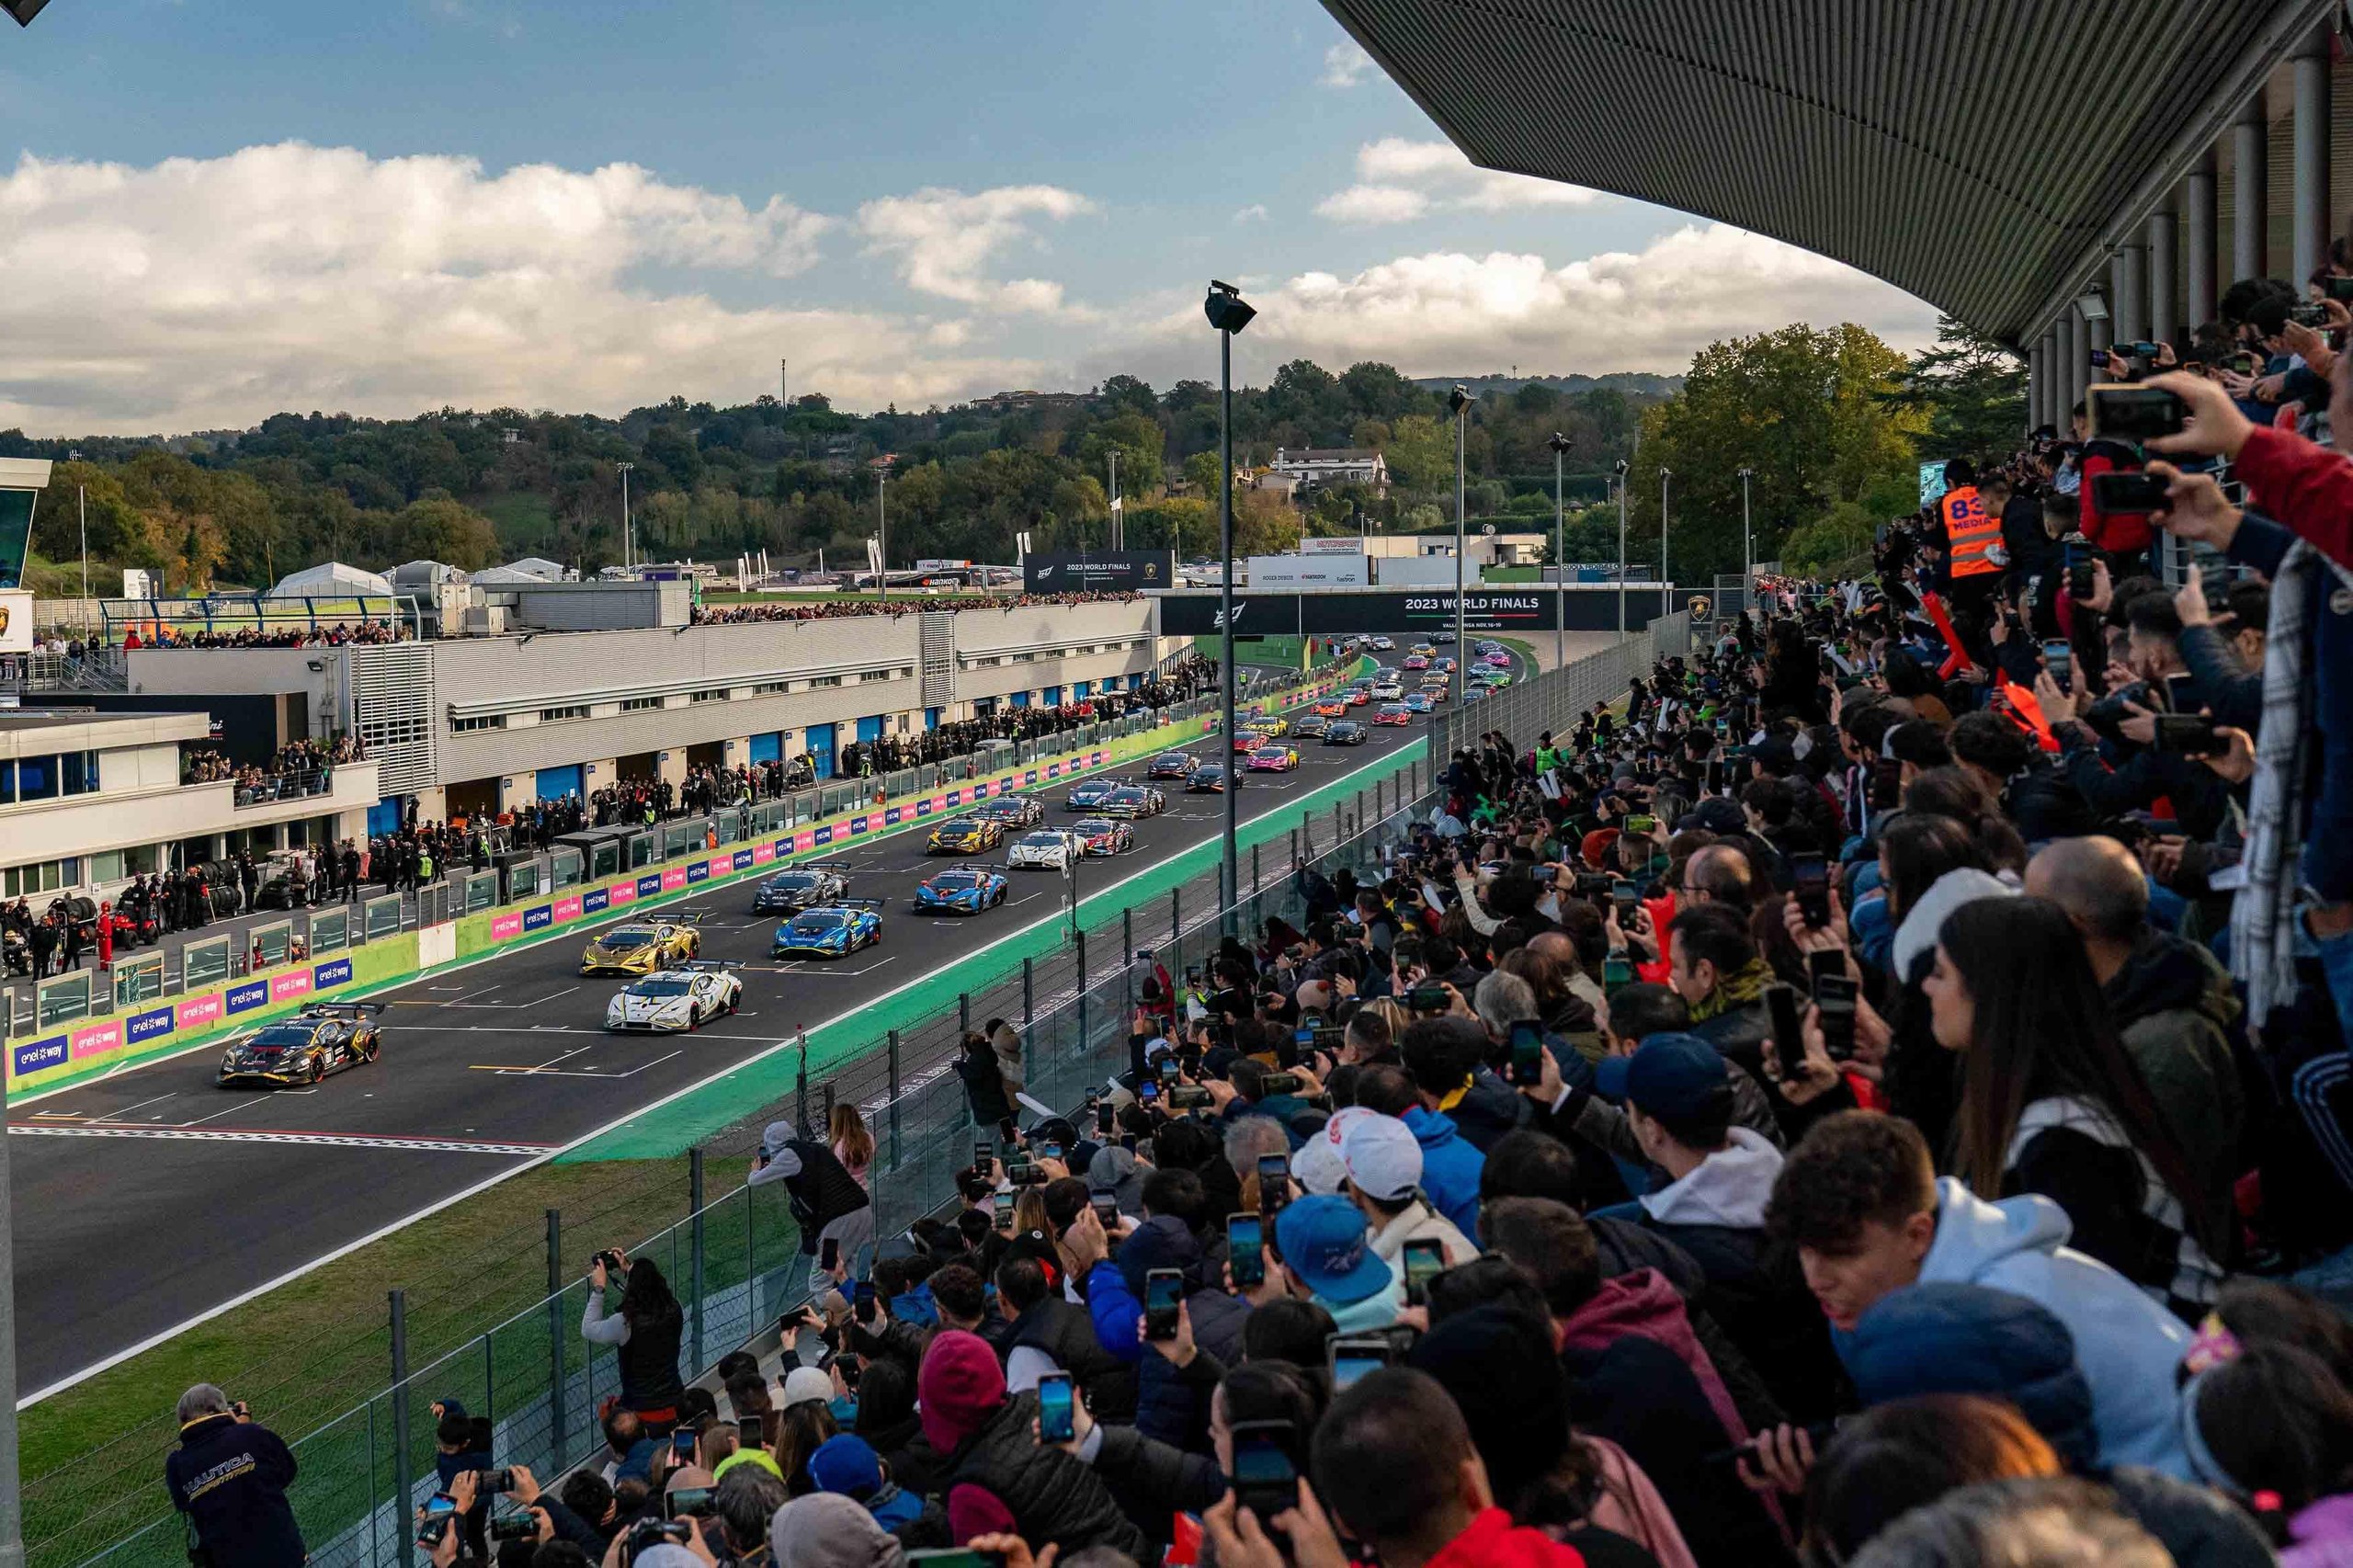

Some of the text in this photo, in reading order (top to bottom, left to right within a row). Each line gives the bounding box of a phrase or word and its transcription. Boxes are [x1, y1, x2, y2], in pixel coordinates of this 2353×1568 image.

[1953, 517, 1992, 529] MEDIA
[1404, 599, 1438, 608] 2023
[1492, 597, 1539, 608] FINALS
[320, 965, 348, 981] enel way
[277, 977, 307, 993] enel way
[232, 989, 264, 1006] enel way
[184, 1001, 218, 1019] enel way
[132, 1016, 169, 1033] enel way
[78, 1030, 117, 1049] enel way
[21, 1044, 63, 1064] enel way
[183, 1452, 255, 1494] NAUTICA
